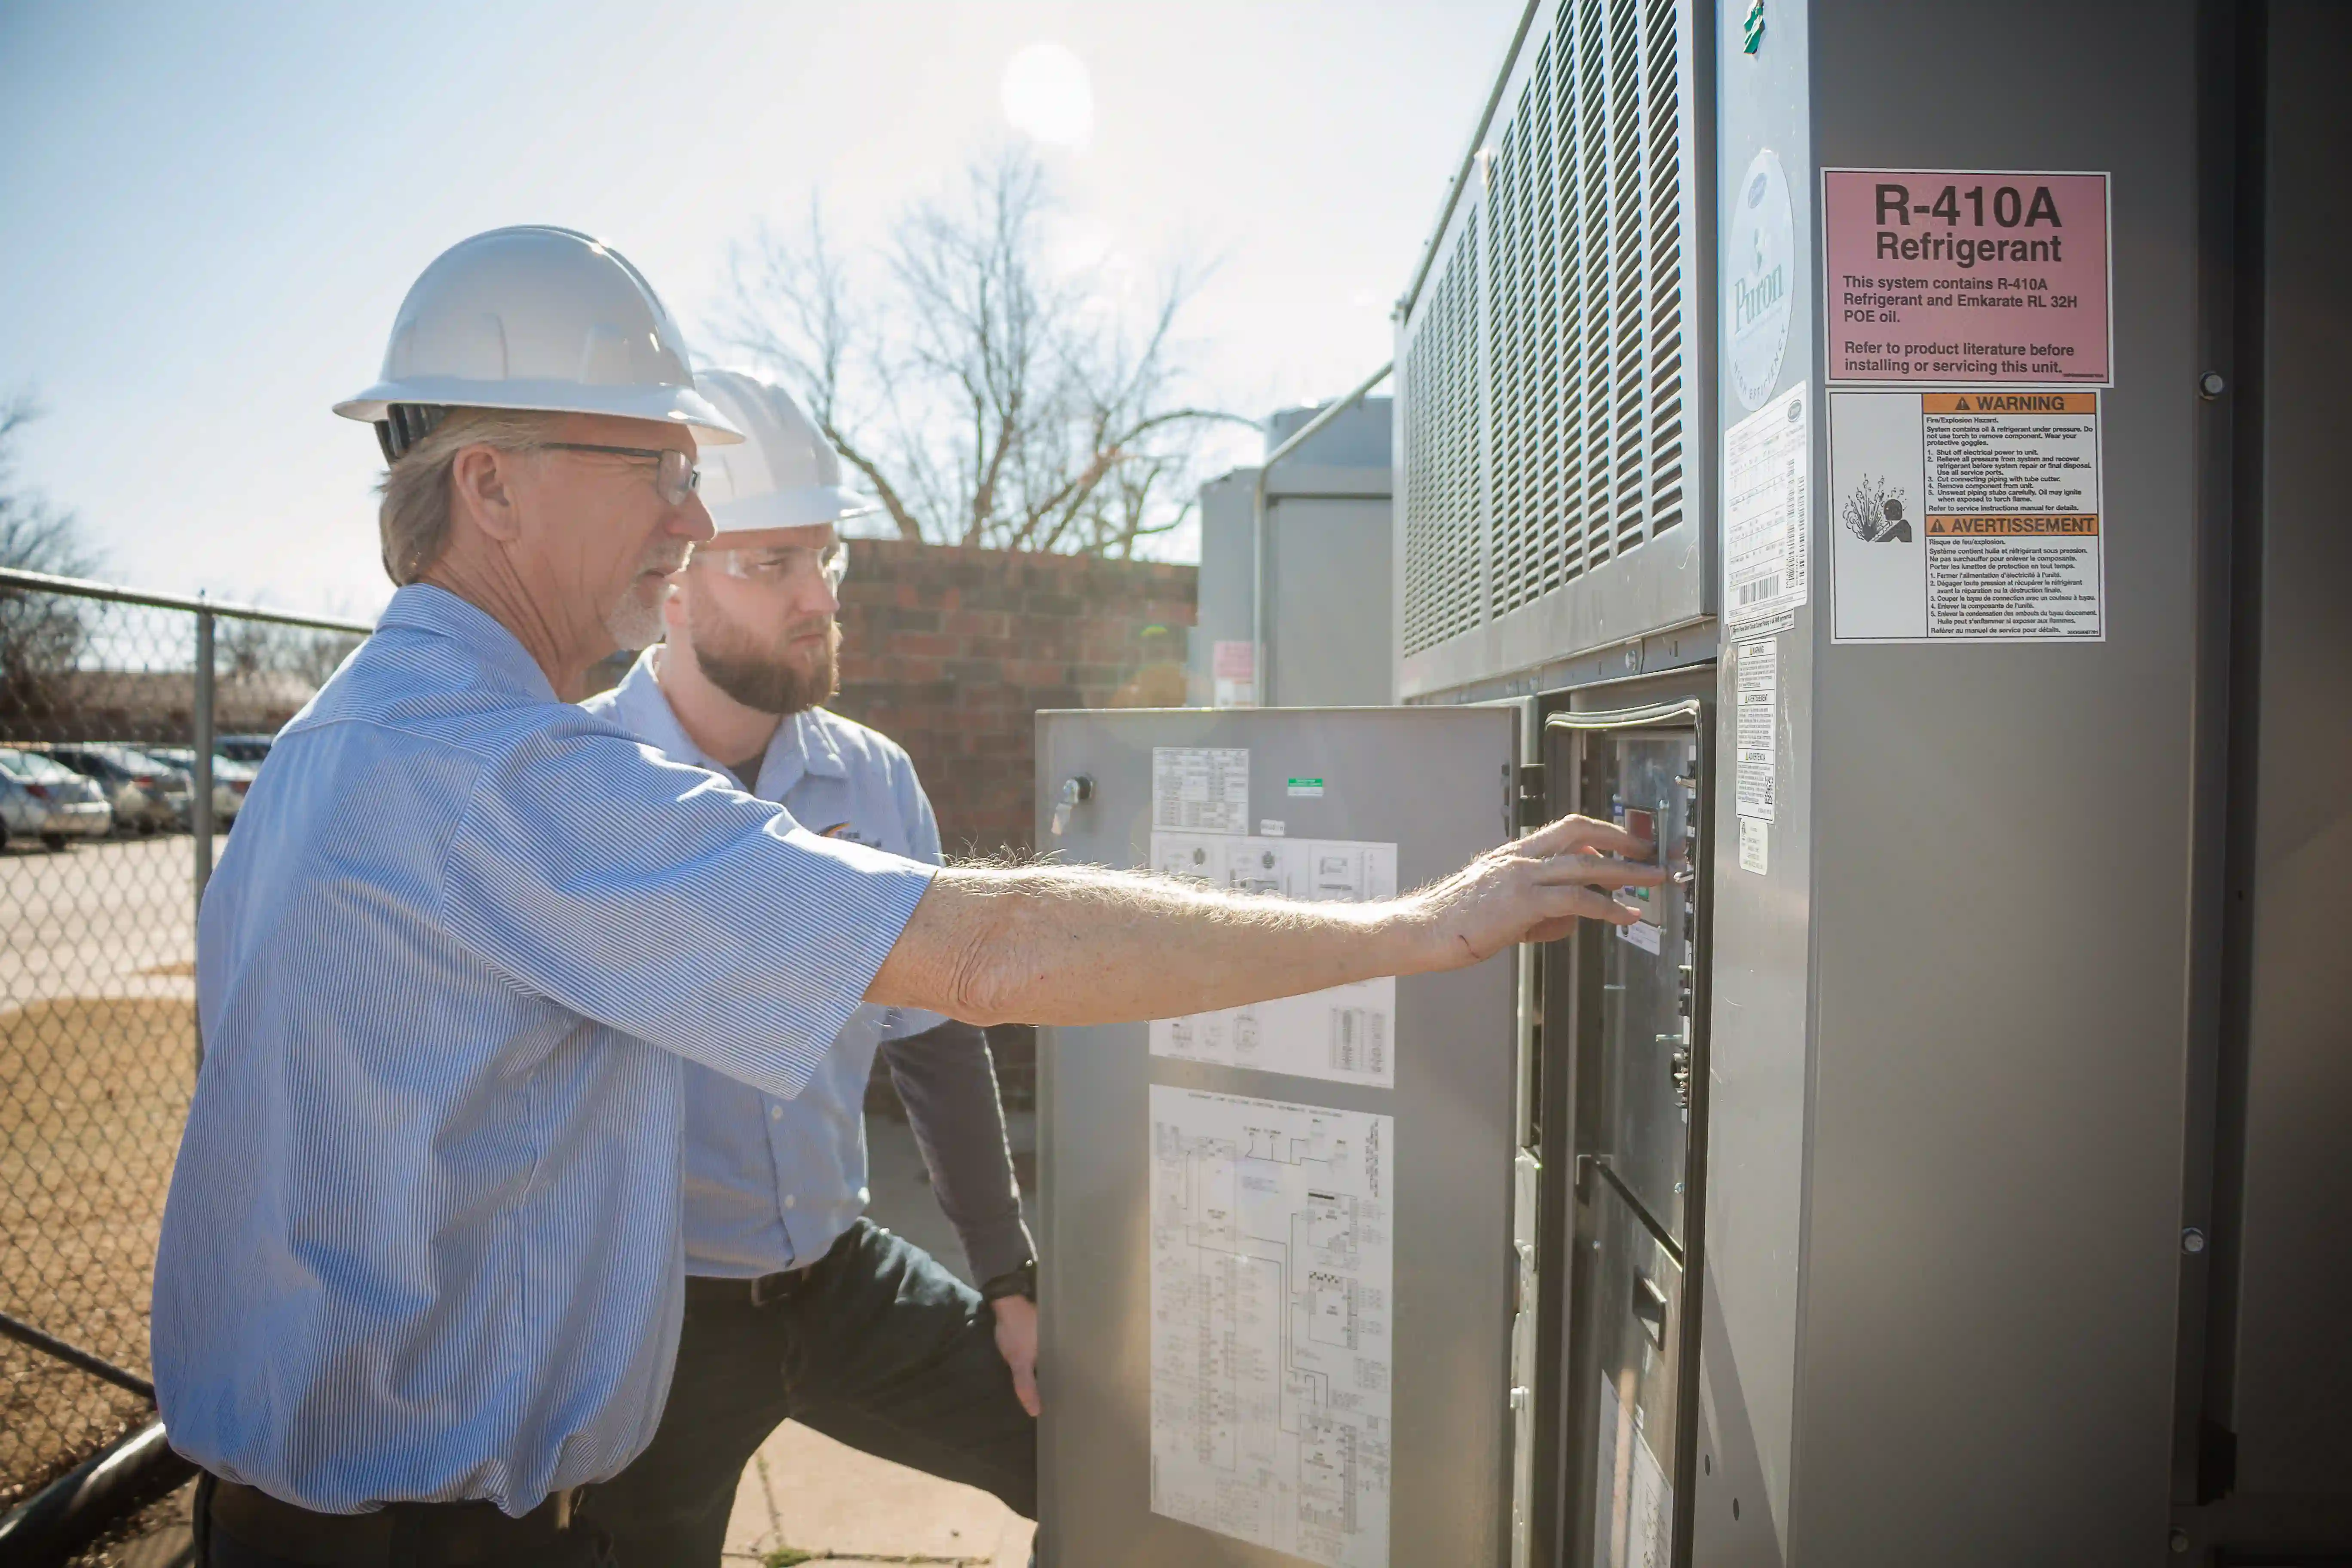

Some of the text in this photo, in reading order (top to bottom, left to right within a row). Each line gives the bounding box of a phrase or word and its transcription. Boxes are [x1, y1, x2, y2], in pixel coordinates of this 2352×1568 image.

[1875, 184, 2062, 228] R-410A
[1877, 232, 2062, 268] Refrigerant
[1842, 275, 2048, 291] This system contains R-410A
[1734, 263, 1784, 335] Puron
[1844, 292, 2077, 309] Refrigerant and Emkarate RL 32H
[1844, 309, 1900, 322] POE oil.
[1844, 341, 2075, 358] Refer to product literature before
[1845, 358, 2064, 376] installing or servicing this unit.
[1976, 396, 2064, 410] WARNING
[1952, 518, 2095, 533] AVERTISSEMENT
